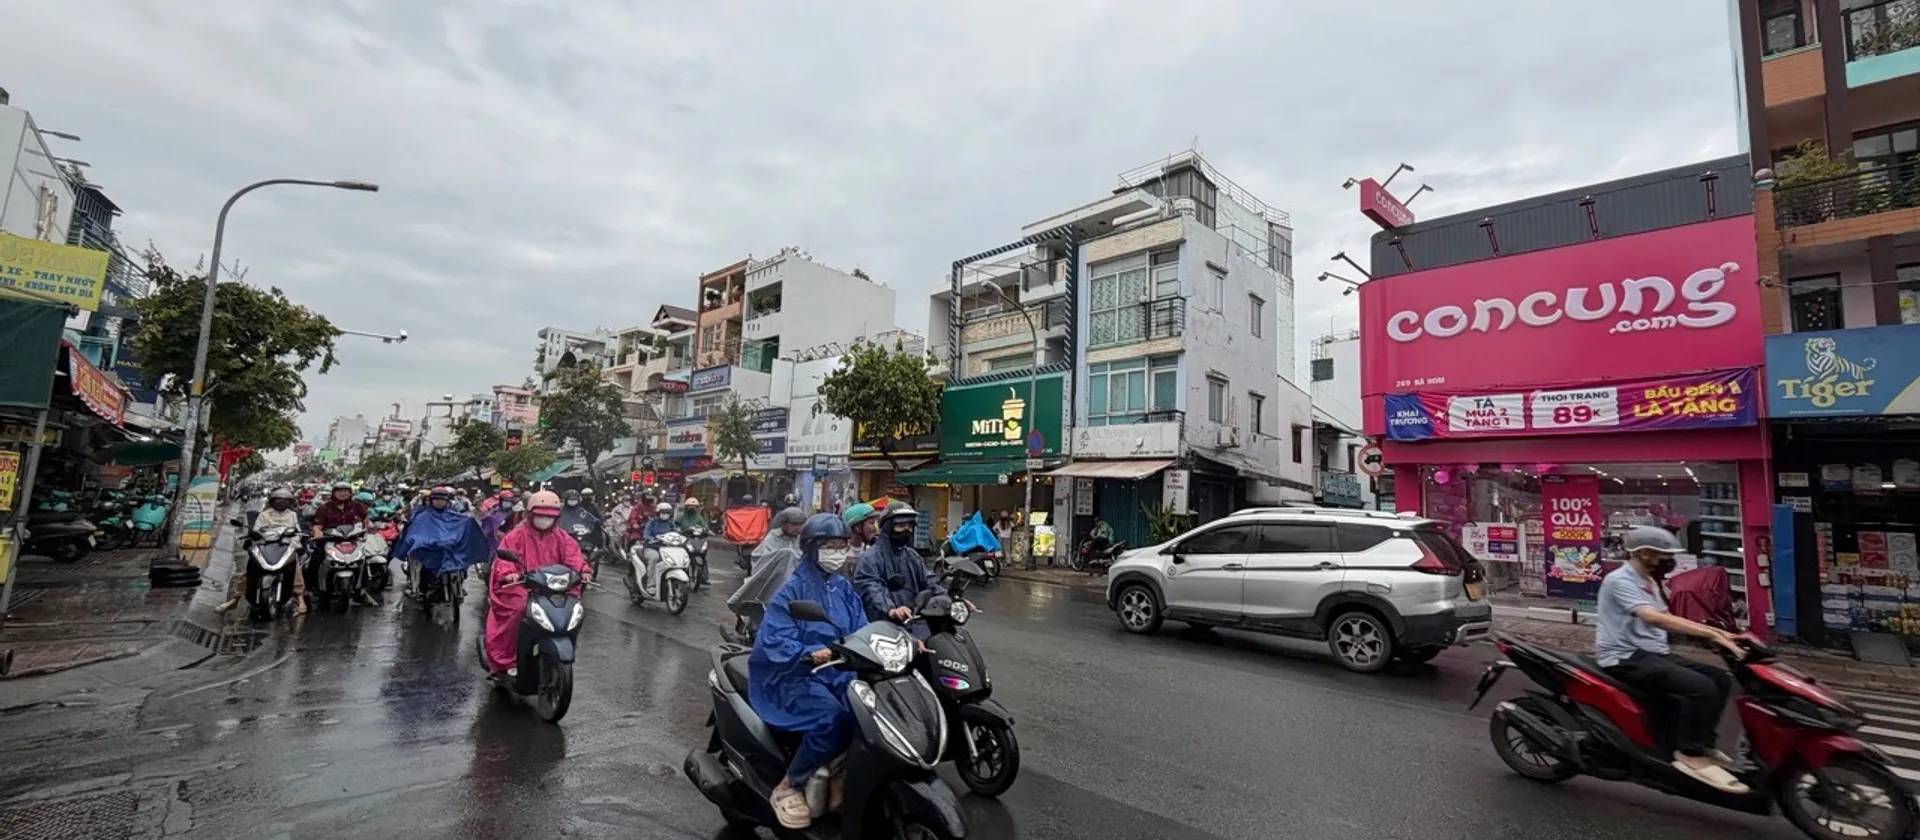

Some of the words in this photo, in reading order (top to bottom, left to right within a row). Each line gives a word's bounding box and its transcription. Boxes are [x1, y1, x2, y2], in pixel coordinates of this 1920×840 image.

[1387, 262, 1740, 342] concung
[1396, 379, 1411, 388] 269
[1777, 375, 1875, 408] Tiger
[1570, 391, 1609, 401] TRANG
[1465, 409, 1494, 418] MUA
[1500, 408, 1508, 416] 2
[1634, 400, 1664, 417] LÀ
[1668, 398, 1737, 417] TẶNG
[972, 418, 1004, 435] MiTi
[1551, 498, 1592, 511] 100%
[1551, 509, 1595, 526] QUÀ
